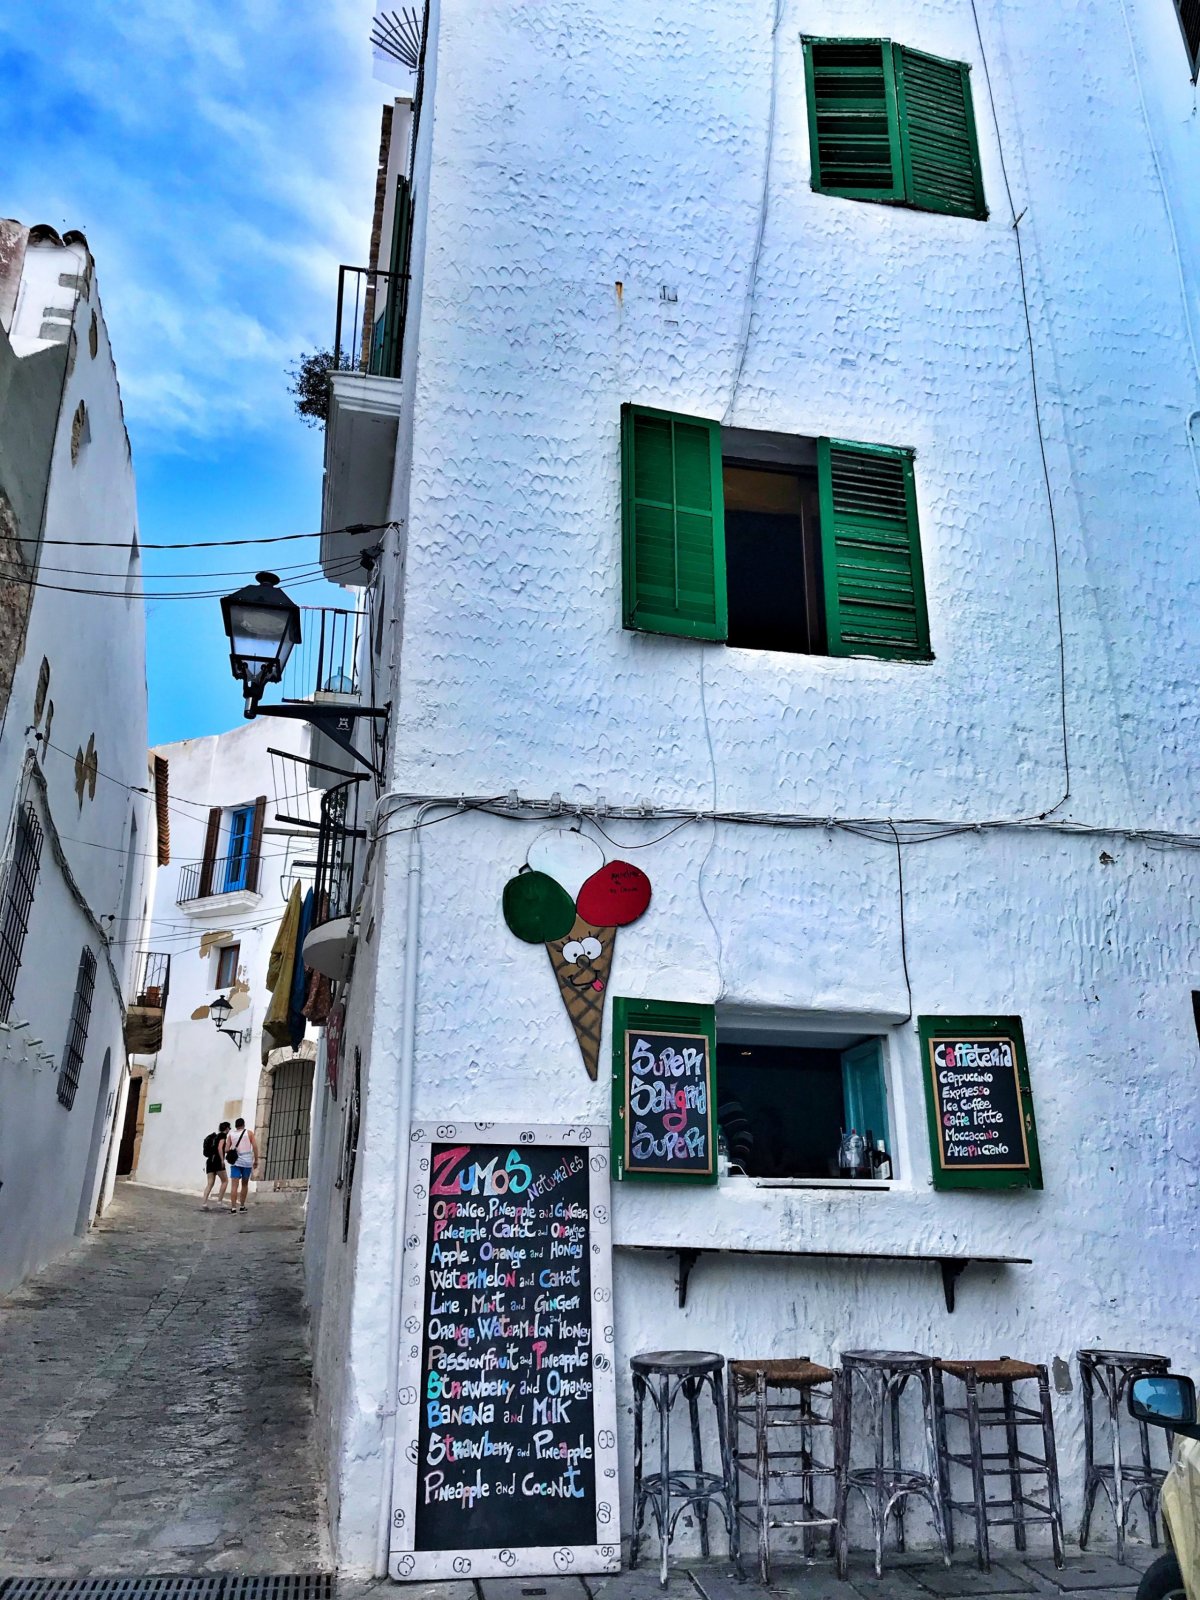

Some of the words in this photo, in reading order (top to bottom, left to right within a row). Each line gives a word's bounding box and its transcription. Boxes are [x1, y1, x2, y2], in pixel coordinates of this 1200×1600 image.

[944, 1099, 958, 1112] Ice
[960, 1098, 992, 1111] Coffee
[944, 1113, 969, 1127] Caffe
[973, 1110, 1003, 1125] latte
